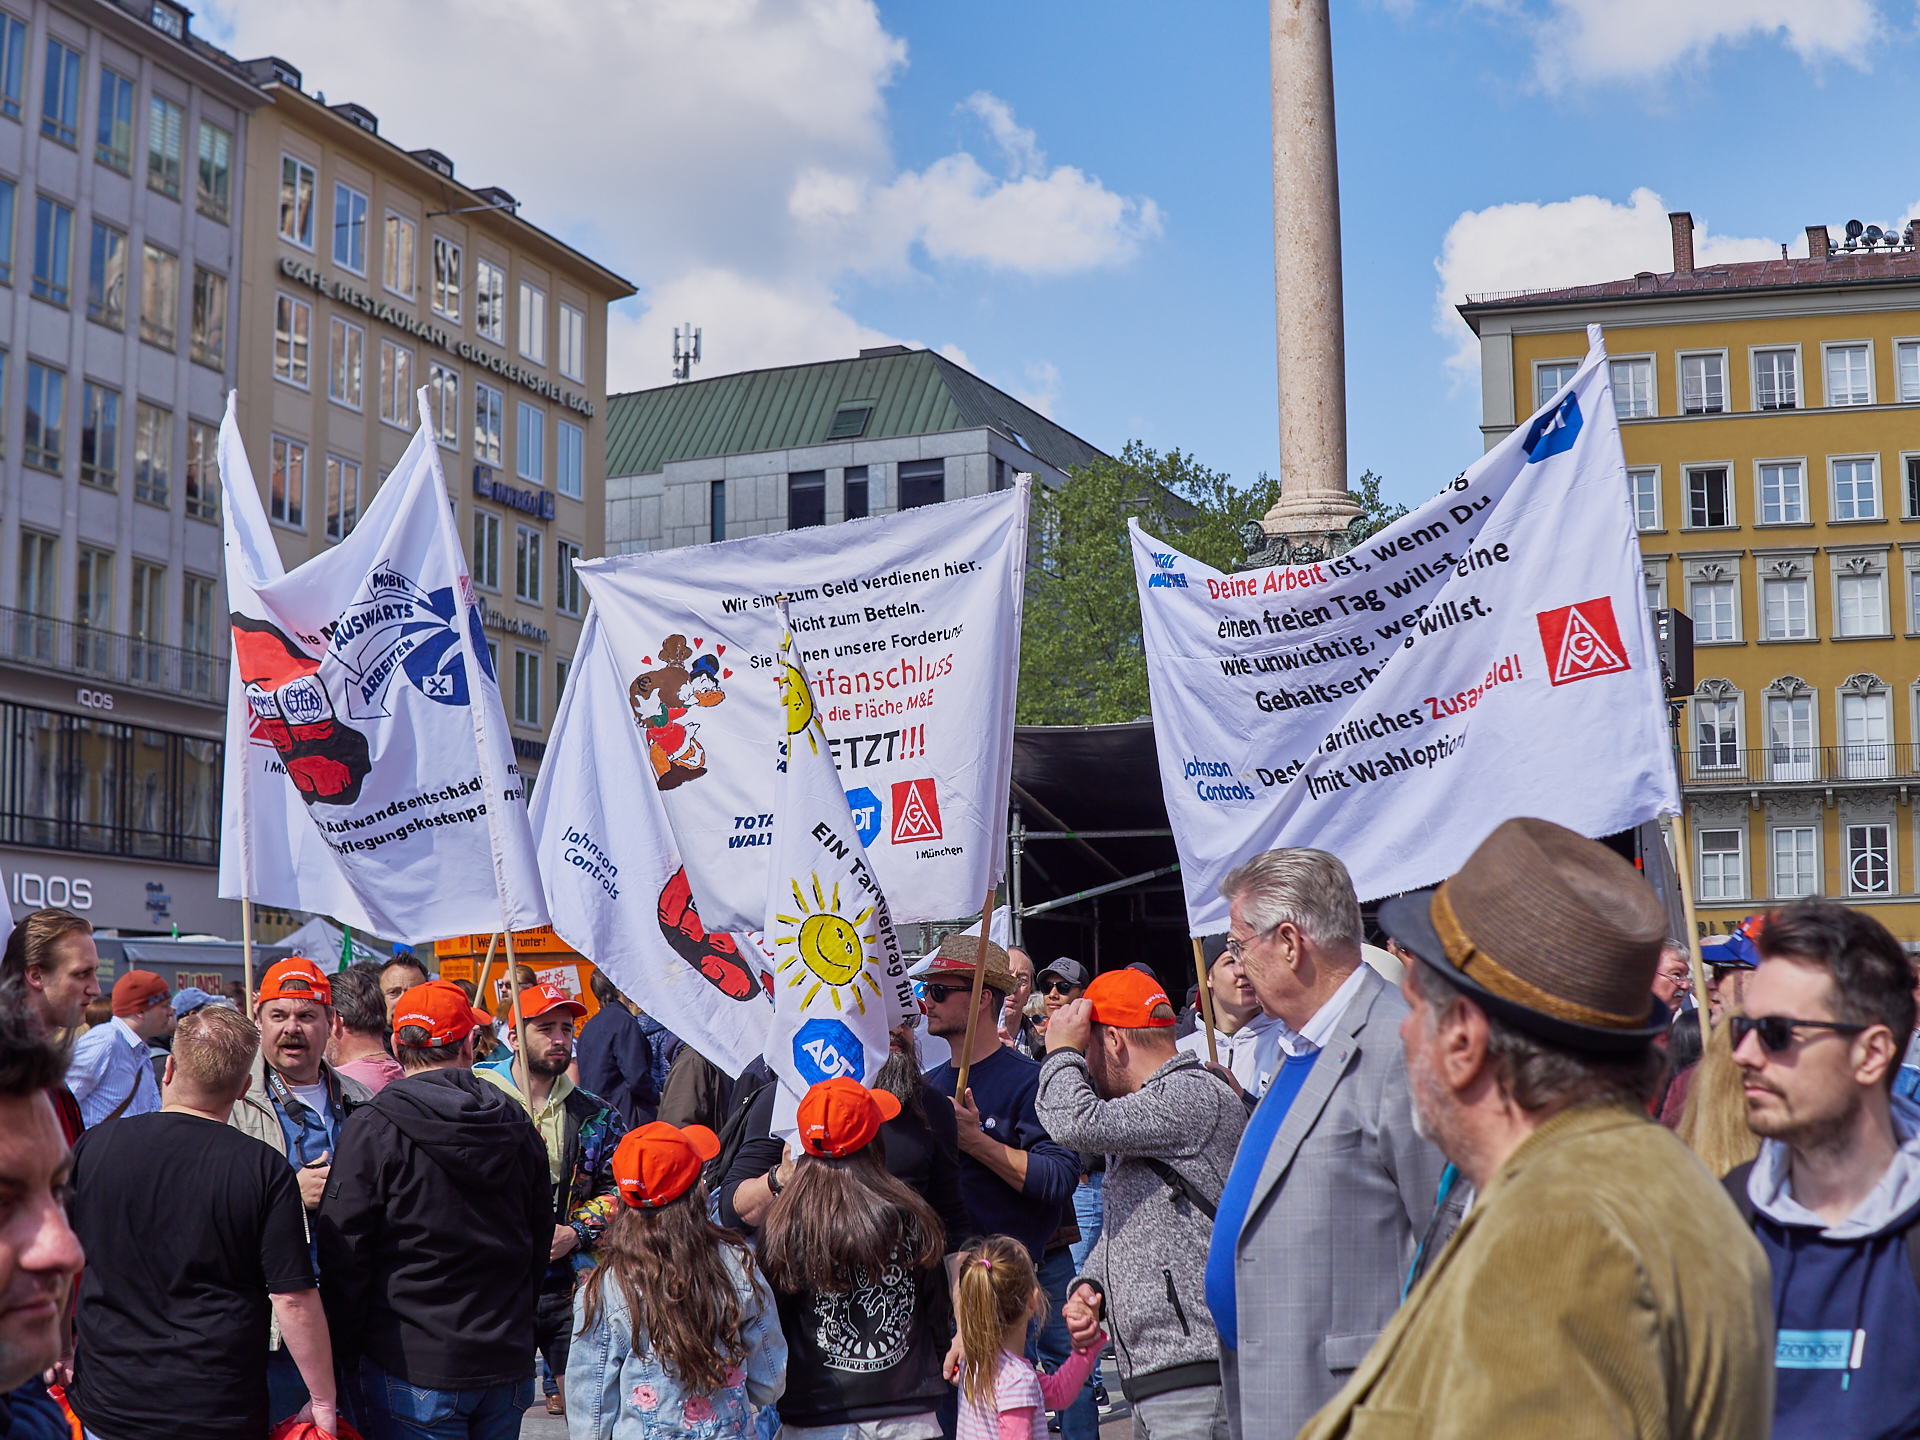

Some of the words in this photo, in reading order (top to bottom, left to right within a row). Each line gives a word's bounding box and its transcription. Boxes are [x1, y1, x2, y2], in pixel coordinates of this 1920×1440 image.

[336, 282, 453, 351] RESTAURANT
[458, 341, 565, 406] GLOCKENSPIEL
[567, 391, 596, 418] BAR
[1206, 576, 1257, 600] Deine
[1262, 563, 1328, 595] Arbeit
[1329, 554, 1372, 578] ist,
[1371, 520, 1450, 562] wenn
[1449, 494, 1492, 524] Du
[373, 573, 409, 591] MOBIL
[722, 597, 748, 614] Wir
[787, 587, 818, 603] zum
[822, 579, 858, 598] Geld
[862, 568, 940, 591] verdienen
[945, 561, 982, 577] hier.
[334, 603, 414, 651] AUSWÄRTS
[828, 611, 860, 628] zum
[864, 602, 925, 622] Betteln.
[1218, 616, 1262, 639] einen
[1263, 605, 1333, 635] freien
[1329, 589, 1387, 616] Tag
[1417, 595, 1493, 636] willst.
[361, 639, 415, 705] ARBEITEN
[750, 653, 773, 669] Sie
[834, 639, 887, 657] unsere
[1220, 654, 1253, 677] wie
[1254, 637, 1375, 673] unwichtig,
[77, 689, 114, 710] IQOS
[829, 706, 850, 722] die
[855, 699, 903, 720] Fläche
[906, 688, 933, 711] M&E
[1316, 707, 1425, 755] arifliches
[1183, 754, 1233, 781] Johnson
[1197, 781, 1255, 801] Controls
[562, 826, 618, 877] Johnson
[921, 846, 963, 860] München
[13, 872, 92, 909] IQOS
[564, 848, 620, 900] Controls
[811, 821, 850, 860] EIN
[895, 979, 914, 1008] für
[802, 1038, 856, 1079] ADT
[270, 1074, 287, 1096] SONY
[868, 1360, 884, 1370] GOT
